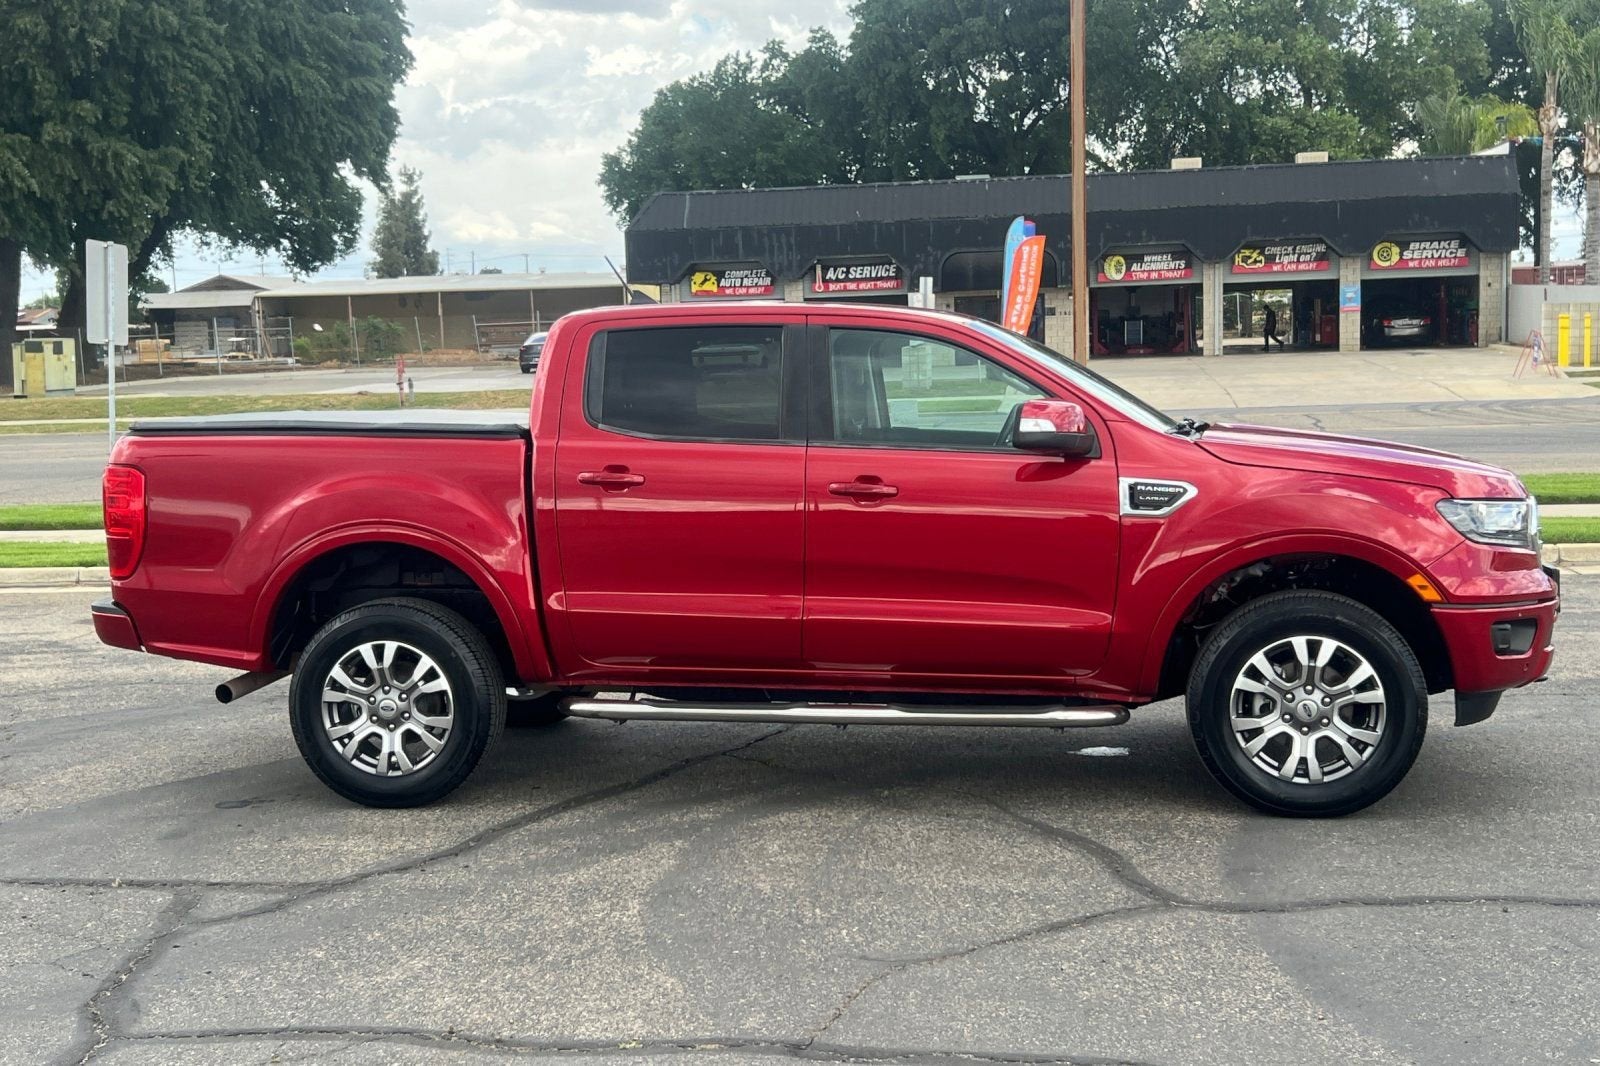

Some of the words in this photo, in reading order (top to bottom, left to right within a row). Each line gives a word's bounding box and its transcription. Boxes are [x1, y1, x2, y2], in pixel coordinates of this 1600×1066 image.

[1265, 246, 1293, 255] CHECK
[1295, 244, 1327, 253] ENGINE
[1409, 240, 1460, 250] BRAKE
[1143, 253, 1172, 262] WHEEL
[1275, 254, 1297, 265] Light
[1299, 252, 1317, 262] on?
[1402, 249, 1467, 260] SERVICE
[1029, 245, 1038, 275] STATION
[1421, 259, 1436, 268] CAN
[1130, 260, 1186, 271] ALIGNMENTS
[1283, 262, 1297, 272] CAN
[724, 269, 767, 278] COMPLETE
[825, 267, 847, 280] A/C
[848, 264, 897, 279] SERVICE
[1132, 272, 1147, 280] STOP
[719, 278, 742, 287] AUTO
[742, 277, 771, 287] REPAIR
[1025, 278, 1034, 302] CHECK
[1011, 295, 1023, 323] STAR
[1137, 485, 1184, 493] RANGER
